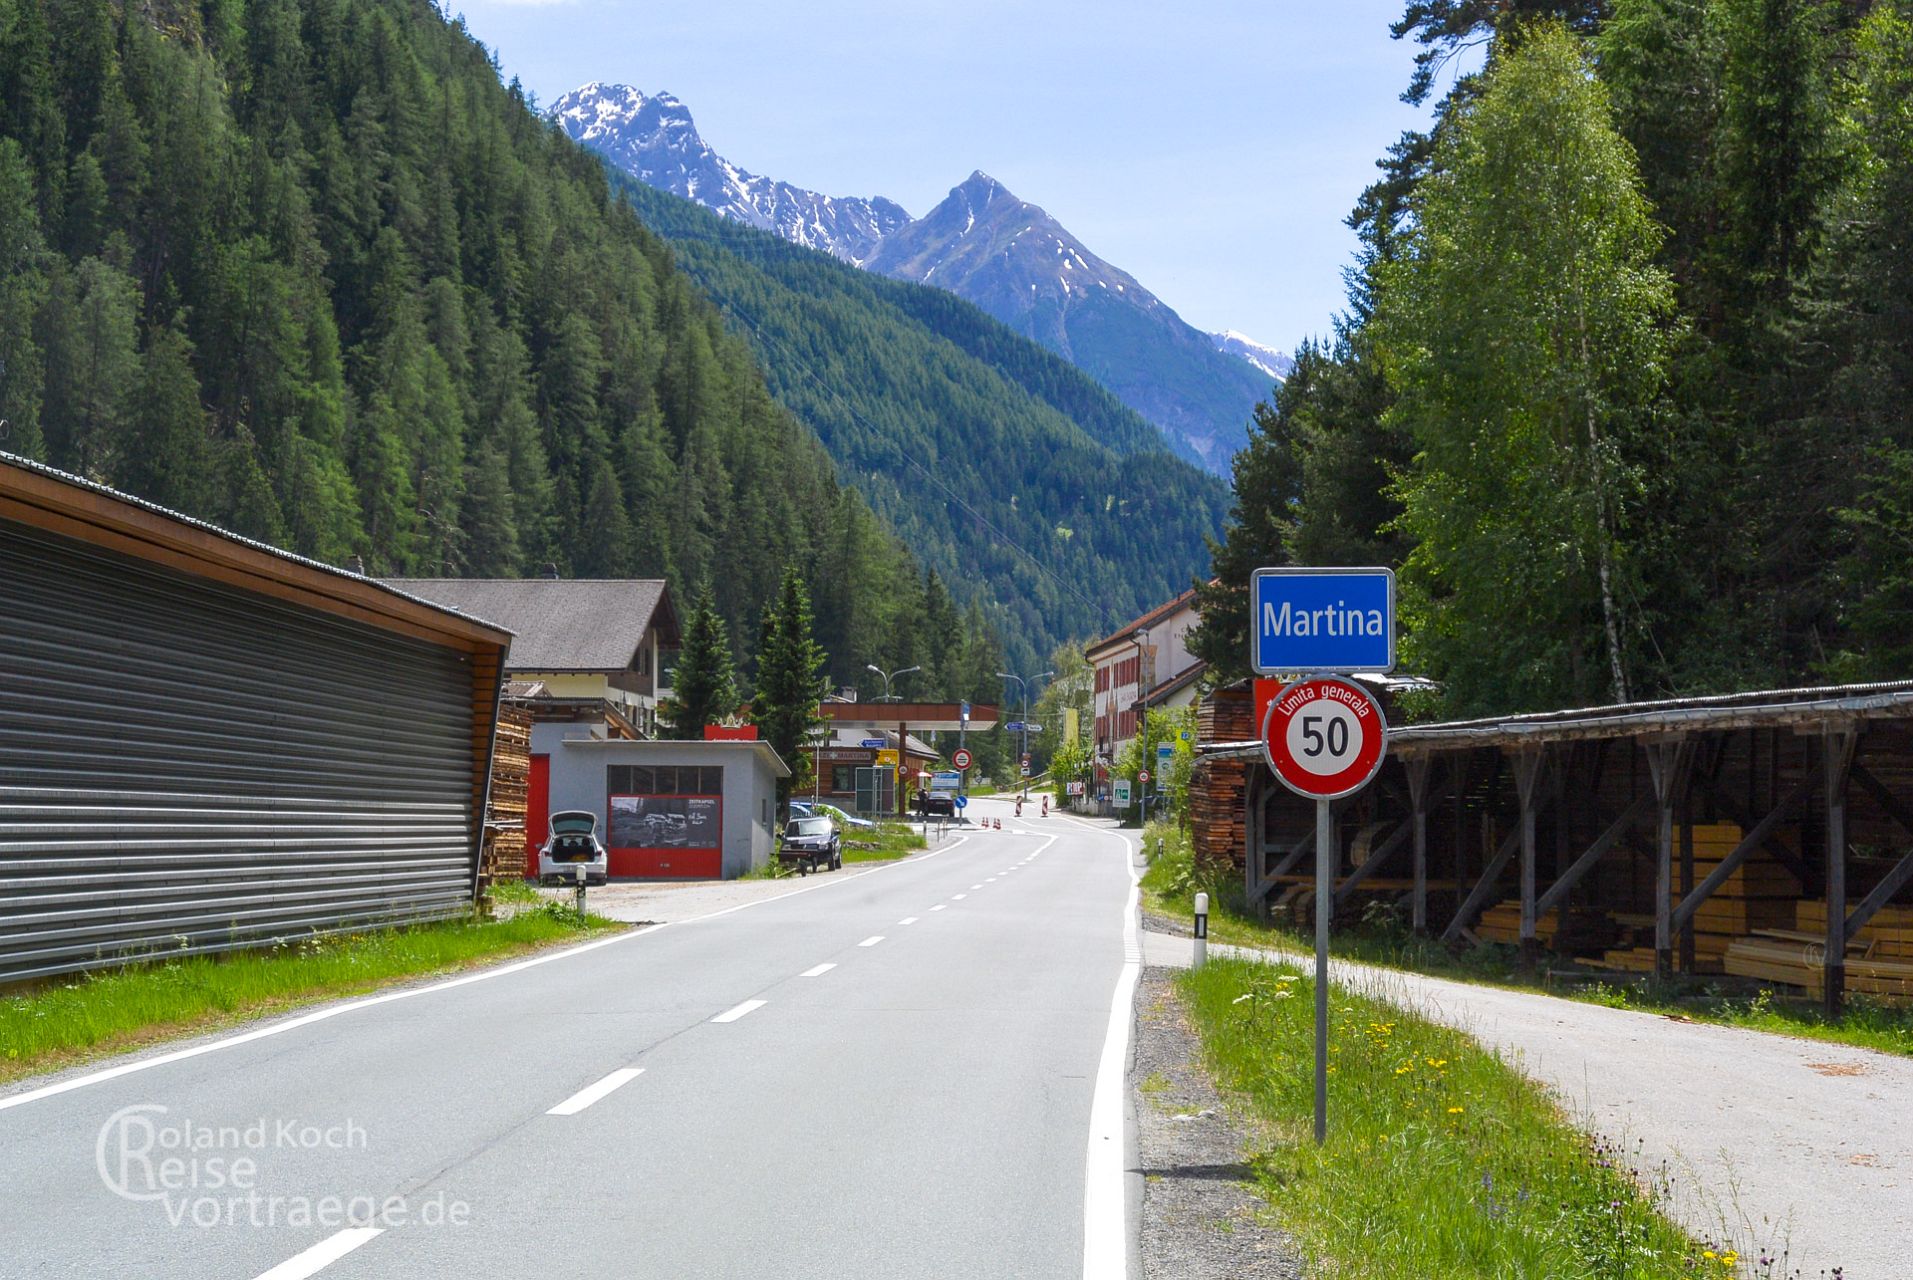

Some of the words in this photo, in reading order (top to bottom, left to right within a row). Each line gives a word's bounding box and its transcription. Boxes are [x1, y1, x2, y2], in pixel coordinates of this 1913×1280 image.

[1264, 601, 1383, 637] Martina
[1278, 687, 1315, 716] Limita
[1321, 685, 1369, 718] generala
[1302, 716, 1349, 757] 50
